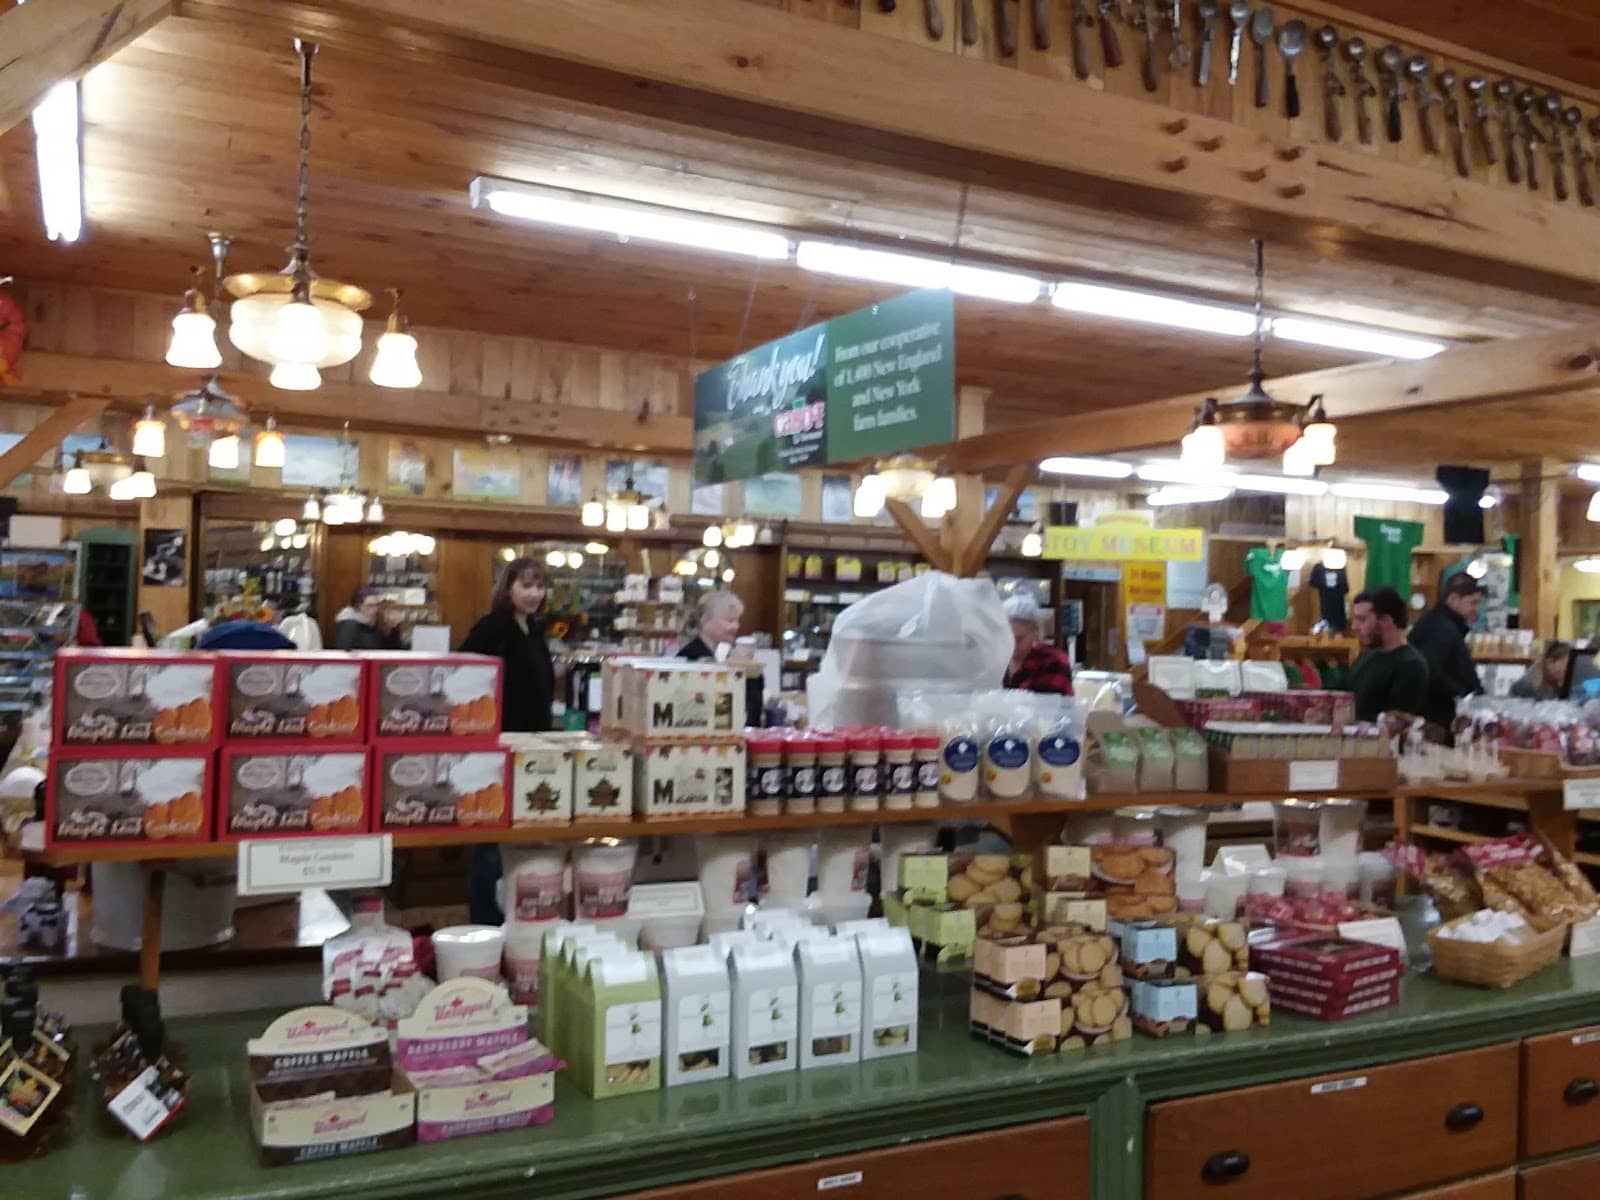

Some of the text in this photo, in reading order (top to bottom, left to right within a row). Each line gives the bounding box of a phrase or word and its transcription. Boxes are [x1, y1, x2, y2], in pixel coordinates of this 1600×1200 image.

[873, 360, 896, 376] New
[897, 343, 942, 373] England
[727, 345, 779, 410] Thank
[872, 385, 895, 402] New
[896, 376, 921, 396] York
[1052, 535, 1197, 554] TOY MUSEUM
[274, 1054, 318, 1069] COFFEE
[322, 1049, 369, 1065] WAFFLE
